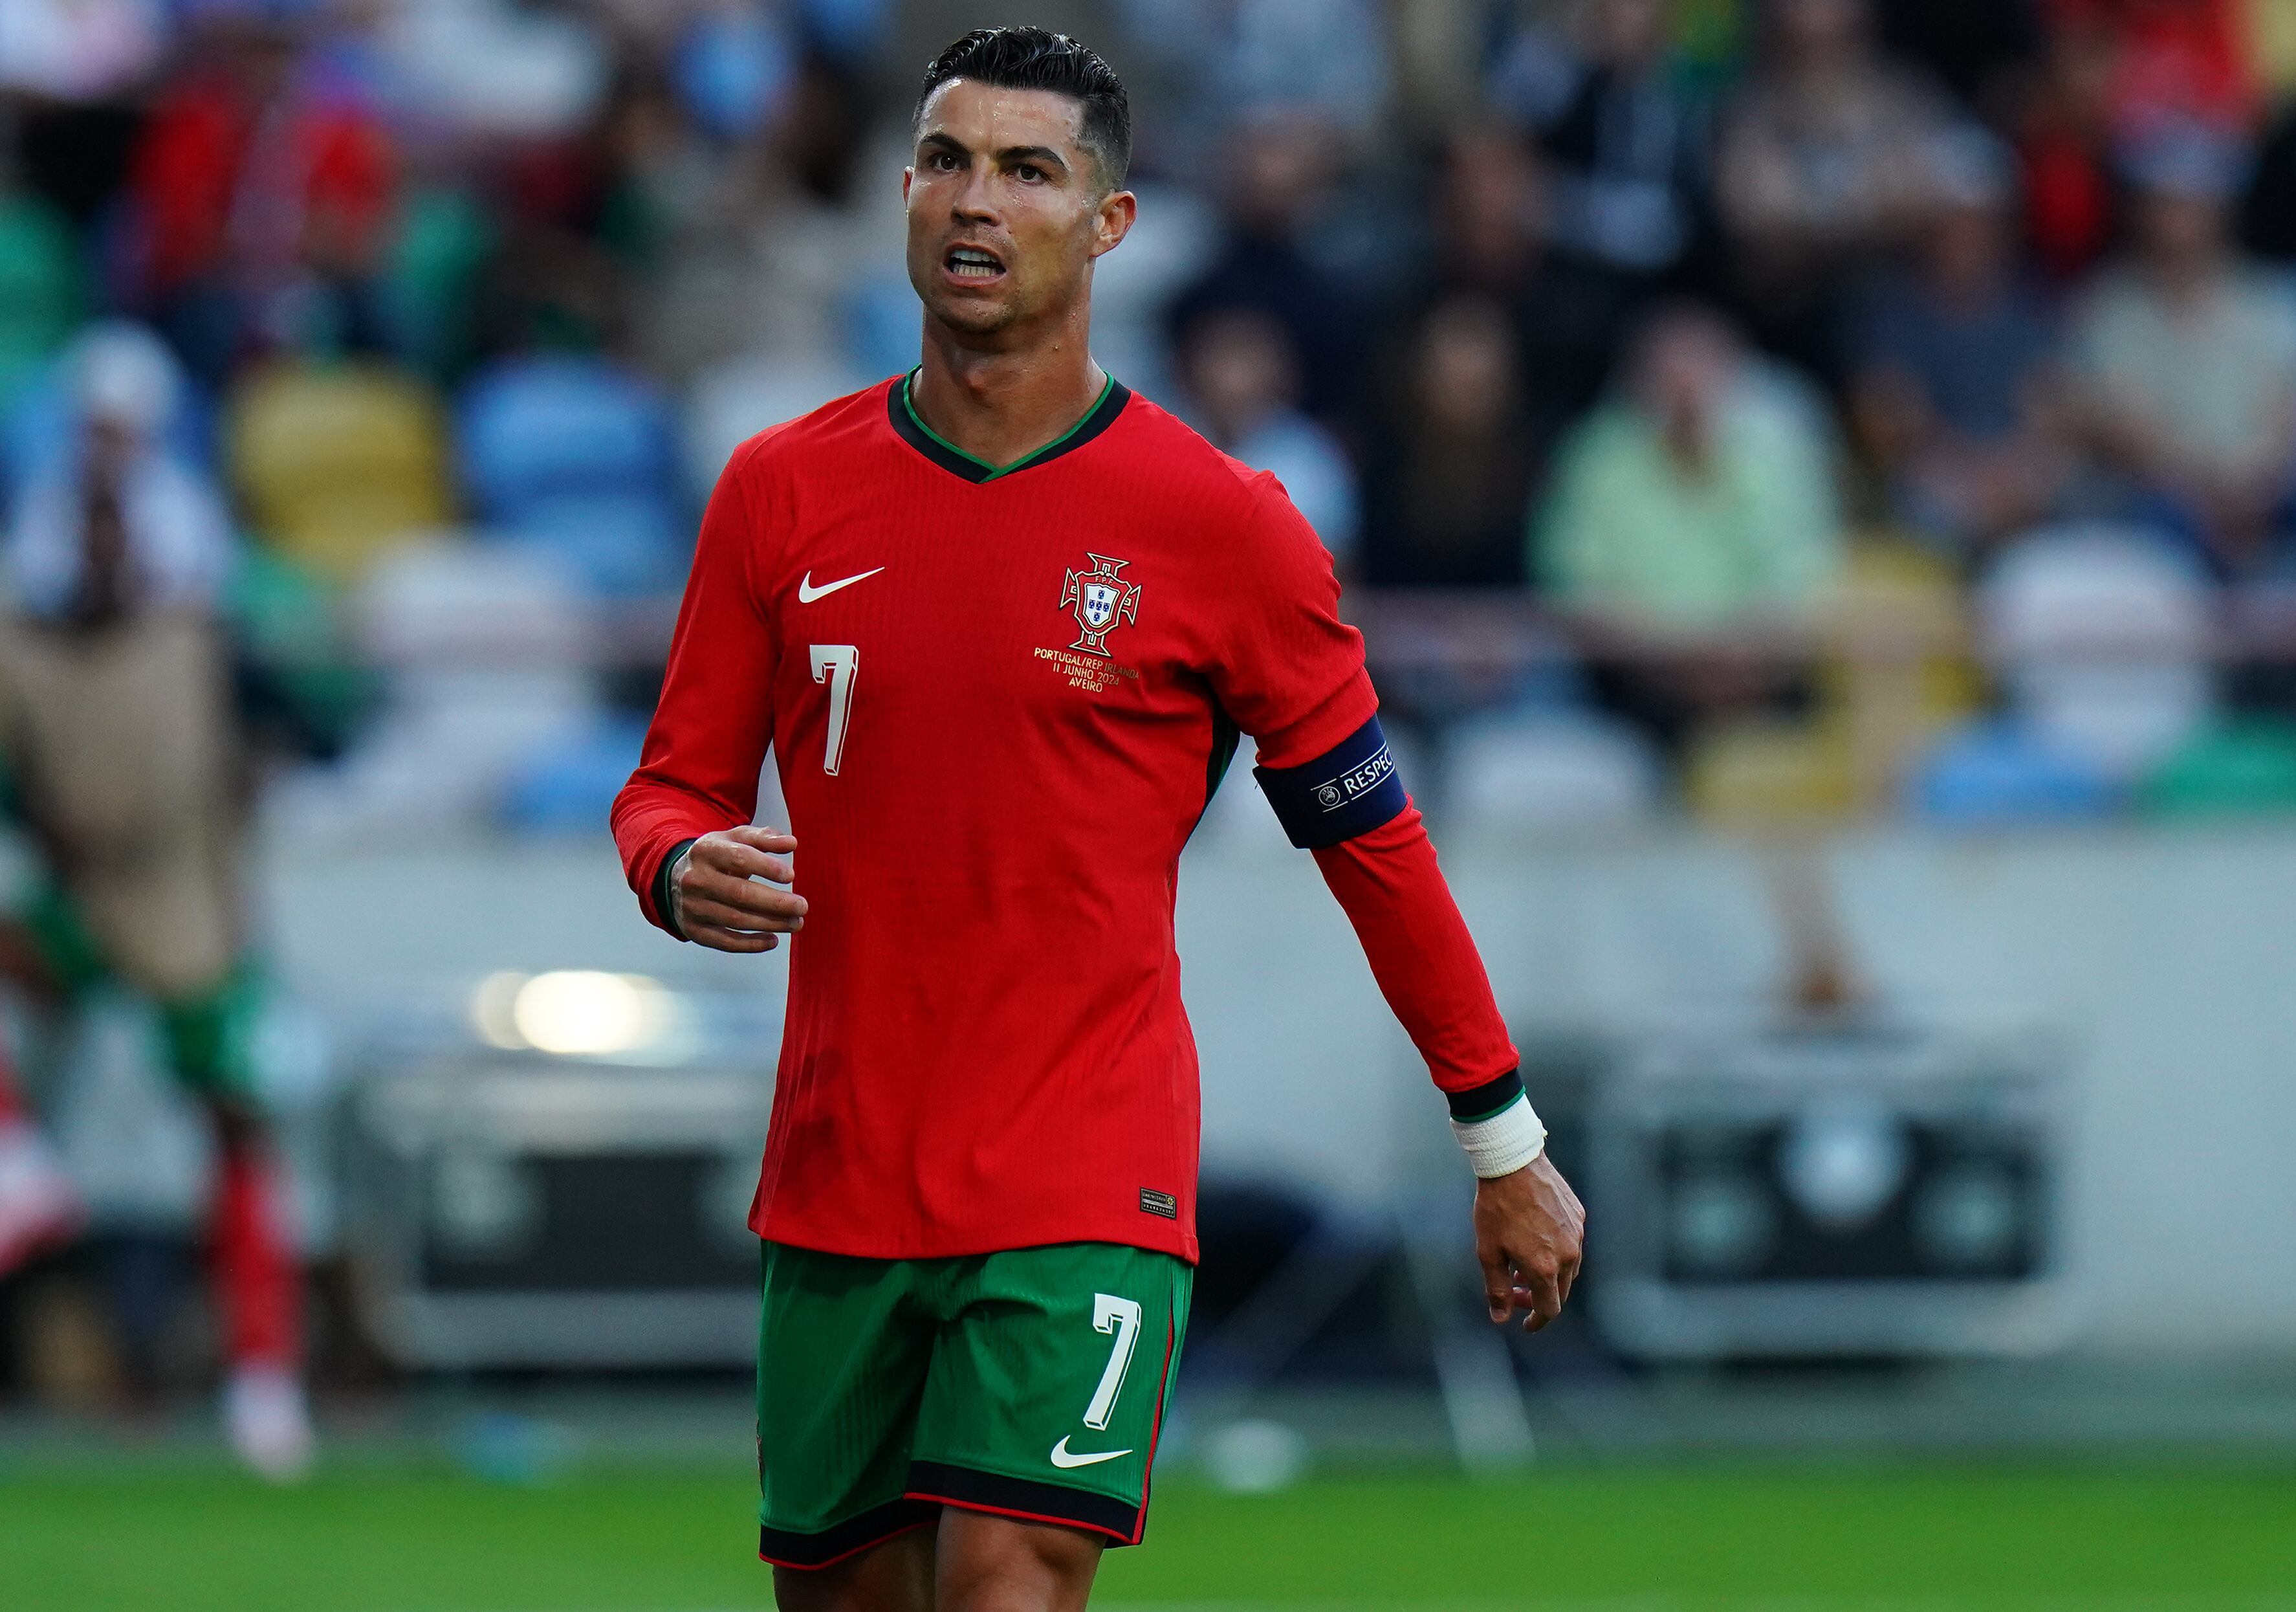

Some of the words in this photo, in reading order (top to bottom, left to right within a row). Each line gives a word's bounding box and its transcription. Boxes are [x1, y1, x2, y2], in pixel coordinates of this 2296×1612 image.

[1062, 665, 1094, 680] JUNHO
[1097, 672, 1120, 686] 2024
[1104, 662, 1139, 679] IRLANDA
[809, 645, 859, 777] 7
[1344, 745, 1393, 795] RESPEC
[1082, 1292, 1142, 1431] 7
